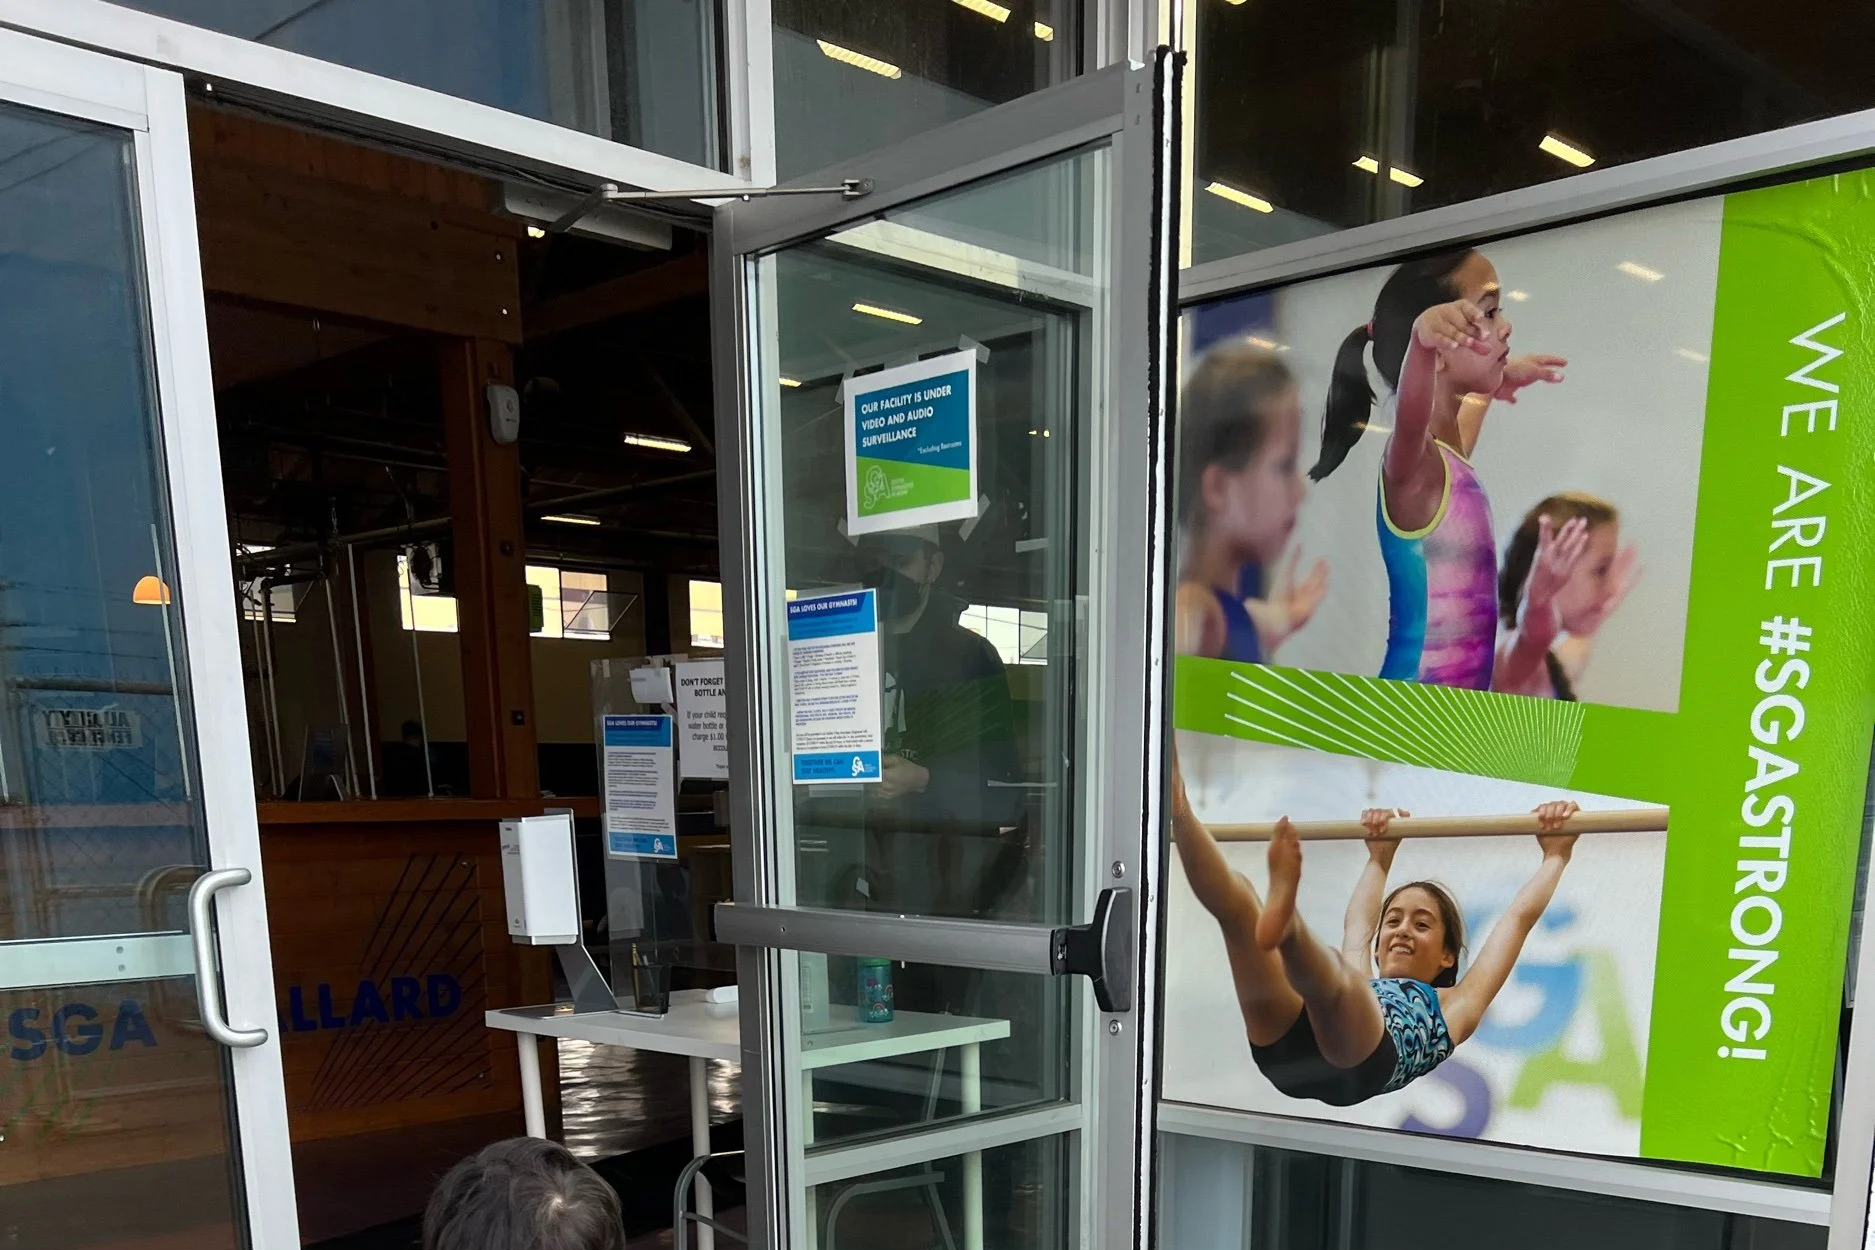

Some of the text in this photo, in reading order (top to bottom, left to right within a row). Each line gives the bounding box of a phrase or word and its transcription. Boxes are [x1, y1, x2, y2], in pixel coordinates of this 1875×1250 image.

[861, 385, 952, 415] OUR FACILITY IS UNDER
[861, 406, 934, 431] VIDEO AND AUDIO
[862, 427, 917, 448] SURVEILLANCE
[801, 603, 816, 613] LOVES
[817, 602, 828, 611] OUR
[681, 677, 723, 687] DON'T FORGET
[1717, 312, 1847, 1060] WE ARE #SGASTRONG!
[694, 689, 726, 697] BOTTLE AN
[692, 712, 703, 720] your
[704, 711, 716, 719] child
[702, 722, 717, 730] bottle
[692, 732, 725, 742] charge $1.00
[8, 973, 463, 1062] SGA LLARD
